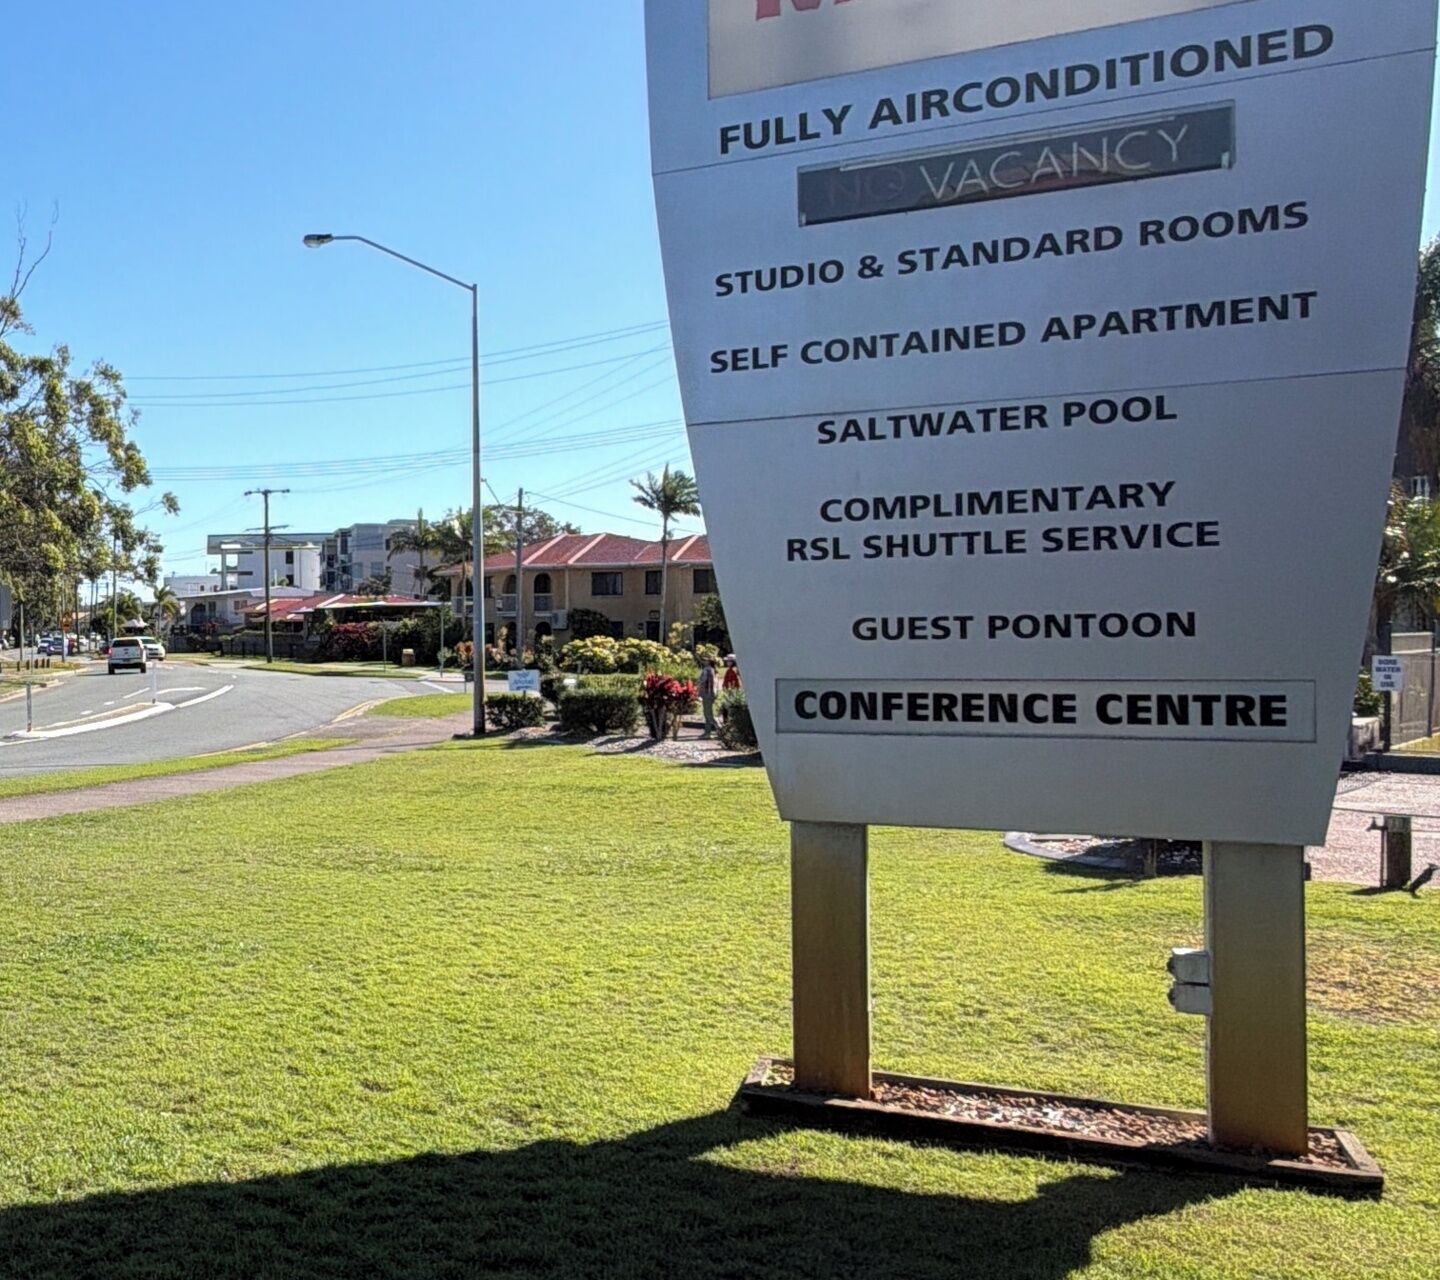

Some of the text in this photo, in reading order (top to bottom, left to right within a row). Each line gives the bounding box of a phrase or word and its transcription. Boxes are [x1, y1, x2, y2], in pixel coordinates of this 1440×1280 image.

[720, 25, 1334, 154] FULLY AIRCONDITIONED
[920, 124, 1189, 200] VACANCY
[716, 201, 1308, 296] STUDIO & STANDARD ROOMS
[711, 291, 1317, 373] SELF CONTAINED APARTMENT
[818, 396, 1177, 444] SALTWATER POOL
[821, 481, 1175, 522] COMPLIMENTARY
[787, 521, 1219, 561] RSL SHUTTLE SERVICE
[853, 612, 1195, 640] GUEST PONTOON
[795, 691, 1286, 726] CONFERENCE CENTRE
